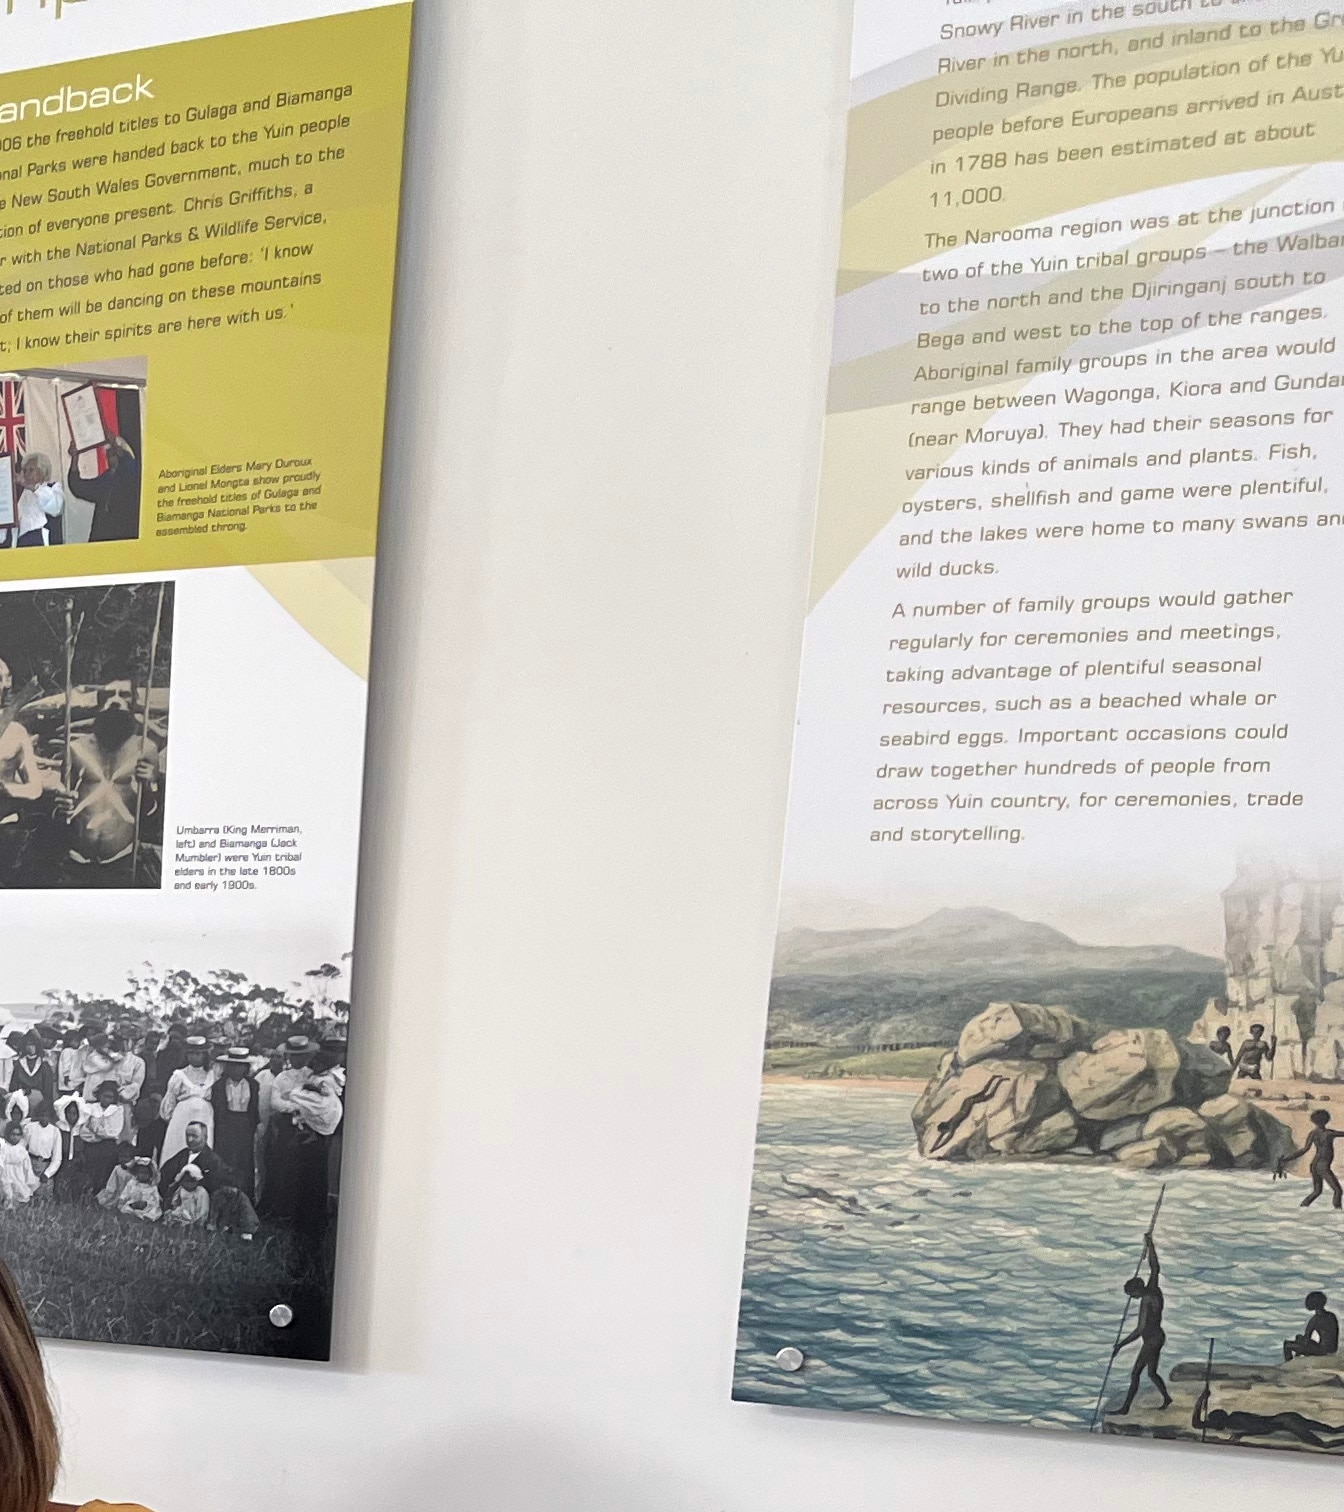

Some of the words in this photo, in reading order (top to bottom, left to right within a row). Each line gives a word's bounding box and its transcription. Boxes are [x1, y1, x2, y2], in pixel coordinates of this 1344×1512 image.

[938, 56, 987, 75] River
[993, 51, 1010, 67] in
[1016, 47, 1050, 65] the
[1058, 36, 1118, 60] north,
[1127, 31, 1164, 52] and
[1171, 23, 1232, 47] inland
[1239, 23, 1264, 39] to
[1270, 16, 1306, 36] the
[1313, 10, 1344, 31] Gr
[26, 133, 51, 148] the
[56, 120, 114, 143] freehold
[119, 116, 158, 133] titles
[164, 113, 180, 126] to
[186, 104, 237, 122] Gulaga
[243, 94, 271, 113] and
[276, 85, 352, 108] Biamanga
[932, 121, 994, 145] people
[1001, 115, 1064, 134] before
[1072, 104, 1178, 127] Europeans
[1186, 90, 1260, 115] arrived
[1266, 89, 1284, 106] in
[27, 160, 66, 177] Parks
[72, 155, 108, 170] were
[112, 142, 165, 164] handed
[170, 136, 204, 155] back
[210, 135, 226, 148] to
[232, 129, 258, 145] the
[263, 123, 294, 139] Yuin
[299, 113, 350, 138] people
[930, 159, 946, 175] in
[956, 152, 1007, 172] 1788
[1014, 151, 1048, 166] has
[1057, 146, 1103, 163] been
[1111, 130, 1218, 157] estimated
[1224, 130, 1246, 145] at
[1254, 122, 1316, 142] about
[880, 730, 950, 747] seabird
[957, 732, 1008, 748] eggs.
[1018, 728, 1118, 746] Important
[1126, 725, 1226, 741] occasions
[1235, 723, 1288, 739] could
[873, 798, 938, 810] across
[946, 793, 983, 809] Yuin
[990, 794, 1070, 811] country,
[1080, 792, 1108, 807] for
[1114, 791, 1237, 808] ceremonies,
[1248, 791, 1303, 806] trade
[176, 826, 220, 835] Umbarra
[222, 825, 248, 836] (King
[250, 824, 302, 834] Merriman,
[870, 826, 904, 842] and
[910, 825, 1024, 844] storytelling.
[176, 839, 196, 849] left)
[198, 839, 216, 849] and
[220, 839, 268, 850] Biamanga
[270, 838, 297, 848] (Jack
[175, 853, 222, 862] Mumbler)
[224, 854, 249, 862] were
[252, 852, 272, 862] Yuin
[275, 852, 302, 862] tribal
[174, 867, 204, 876] elders
[219, 867, 236, 876] the
[240, 867, 259, 876] late
[263, 866, 296, 876] 1800s
[174, 881, 192, 890] and
[194, 881, 218, 892] early
[222, 880, 257, 890] 1900s.
